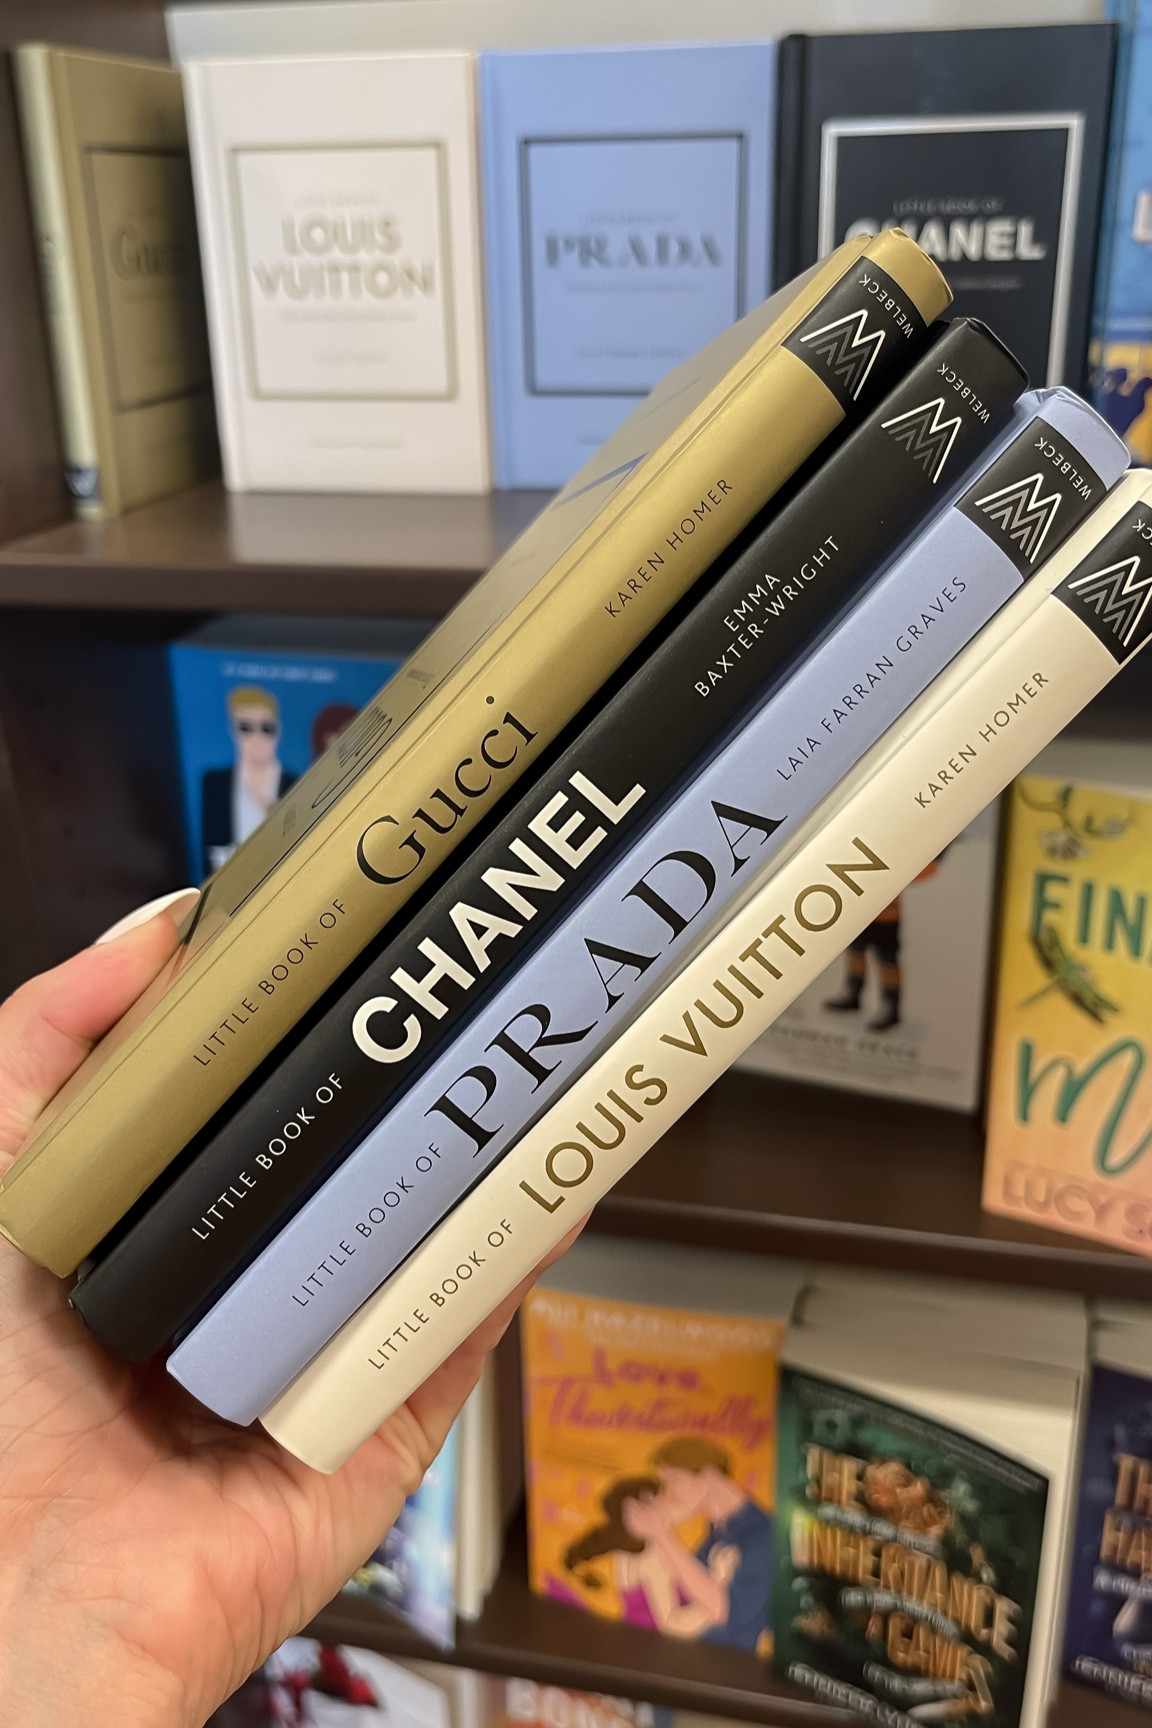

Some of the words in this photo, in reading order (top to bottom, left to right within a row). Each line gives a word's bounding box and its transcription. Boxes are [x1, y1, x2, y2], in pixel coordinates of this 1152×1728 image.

[281, 214, 402, 256] LOUIS
[546, 230, 722, 268] PRADA
[845, 216, 1046, 262] ANEL
[252, 258, 438, 300] VUITTON
[858, 274, 915, 339] WELBECK
[936, 362, 990, 424] WELBECK
[1034, 437, 1092, 500] WELBECK
[604, 552, 666, 619] KAREN
[666, 479, 733, 549] HOMER
[694, 535, 840, 698] BAXTER-WRIGHT
[723, 573, 781, 633] EMMA
[777, 735, 822, 781] LAIA
[821, 655, 894, 733] FARRAN
[895, 575, 968, 653] GRAVES
[915, 745, 978, 809] KAREN
[979, 671, 1049, 742] HOMER
[193, 998, 259, 1067] LITTLE
[259, 934, 319, 995] BOOK
[320, 899, 347, 929] OF
[356, 695, 539, 885] Gucci
[1031, 870, 1152, 962] FIN
[192, 1172, 257, 1240] LITTLE
[256, 1107, 315, 1170] BOOK
[316, 1073, 343, 1104] OF
[352, 770, 646, 1065] CHANEL
[424, 799, 788, 1158] PRADA
[368, 1309, 430, 1370] LITTLE
[430, 1250, 486, 1307] BOOK
[487, 1218, 514, 1248] OF
[519, 1065, 668, 1214] LOUIS
[659, 837, 890, 1057] VUITTON
[416, 1142, 443, 1172] OF
[356, 1177, 415, 1239] BOOK
[292, 1240, 356, 1308] LITTLE
